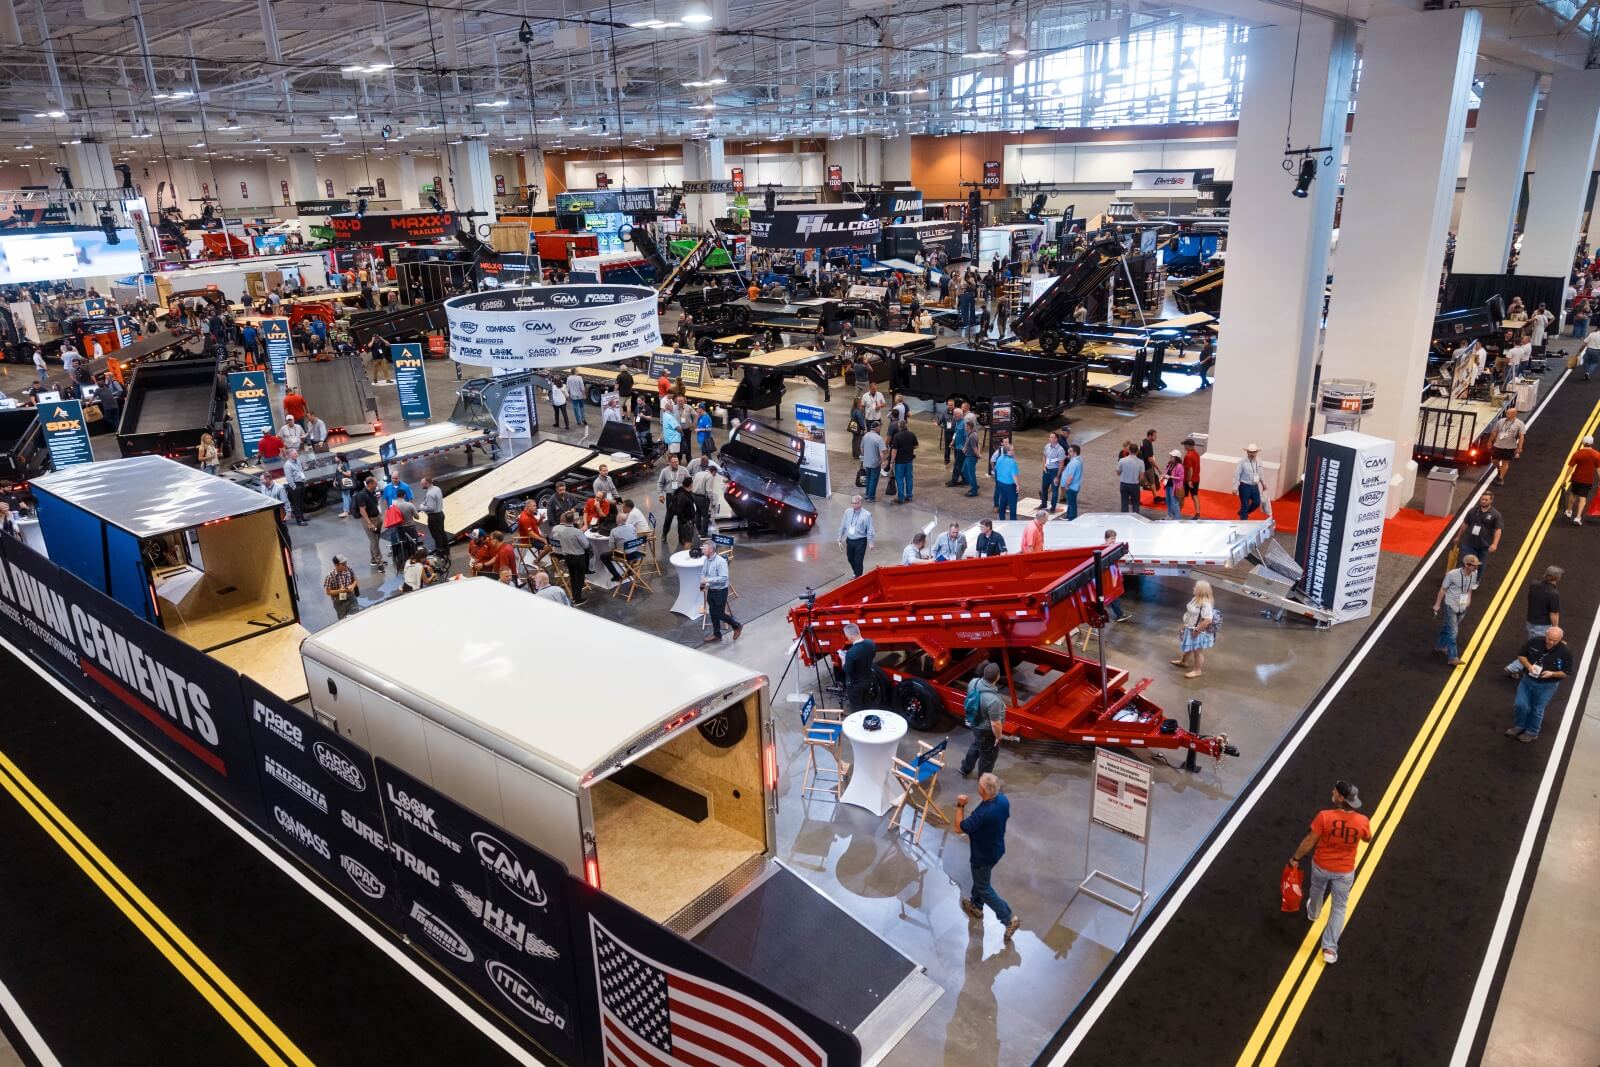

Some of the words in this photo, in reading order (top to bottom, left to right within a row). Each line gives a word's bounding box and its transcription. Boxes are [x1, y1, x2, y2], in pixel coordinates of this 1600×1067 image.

[796, 214, 881, 243] HILLCREST
[266, 332, 288, 340] UTX
[486, 325, 516, 333] COMPASS
[525, 322, 553, 331] CAM
[590, 331, 629, 341] SURE-TRAC
[235, 388, 265, 398] GDX
[1342, 400, 1359, 411] trp
[46, 419, 81, 431] SDX
[1365, 458, 1387, 468] CAM
[1323, 459, 1340, 511] DRIVING
[1353, 525, 1380, 538] COMPASS
[269, 725, 305, 752] AMERICAN
[316, 744, 361, 781] CARGO
[319, 756, 363, 790] EXPRESS
[386, 782, 439, 831] LOOK
[274, 805, 332, 860] COMPASS
[394, 805, 462, 854] TRAILERS
[341, 809, 440, 888] SURE-TRAC
[340, 854, 386, 893] IMPACT
[477, 839, 541, 896] CAM
[409, 900, 467, 955] FORMULA
[497, 968, 566, 1031] ITICARGO
